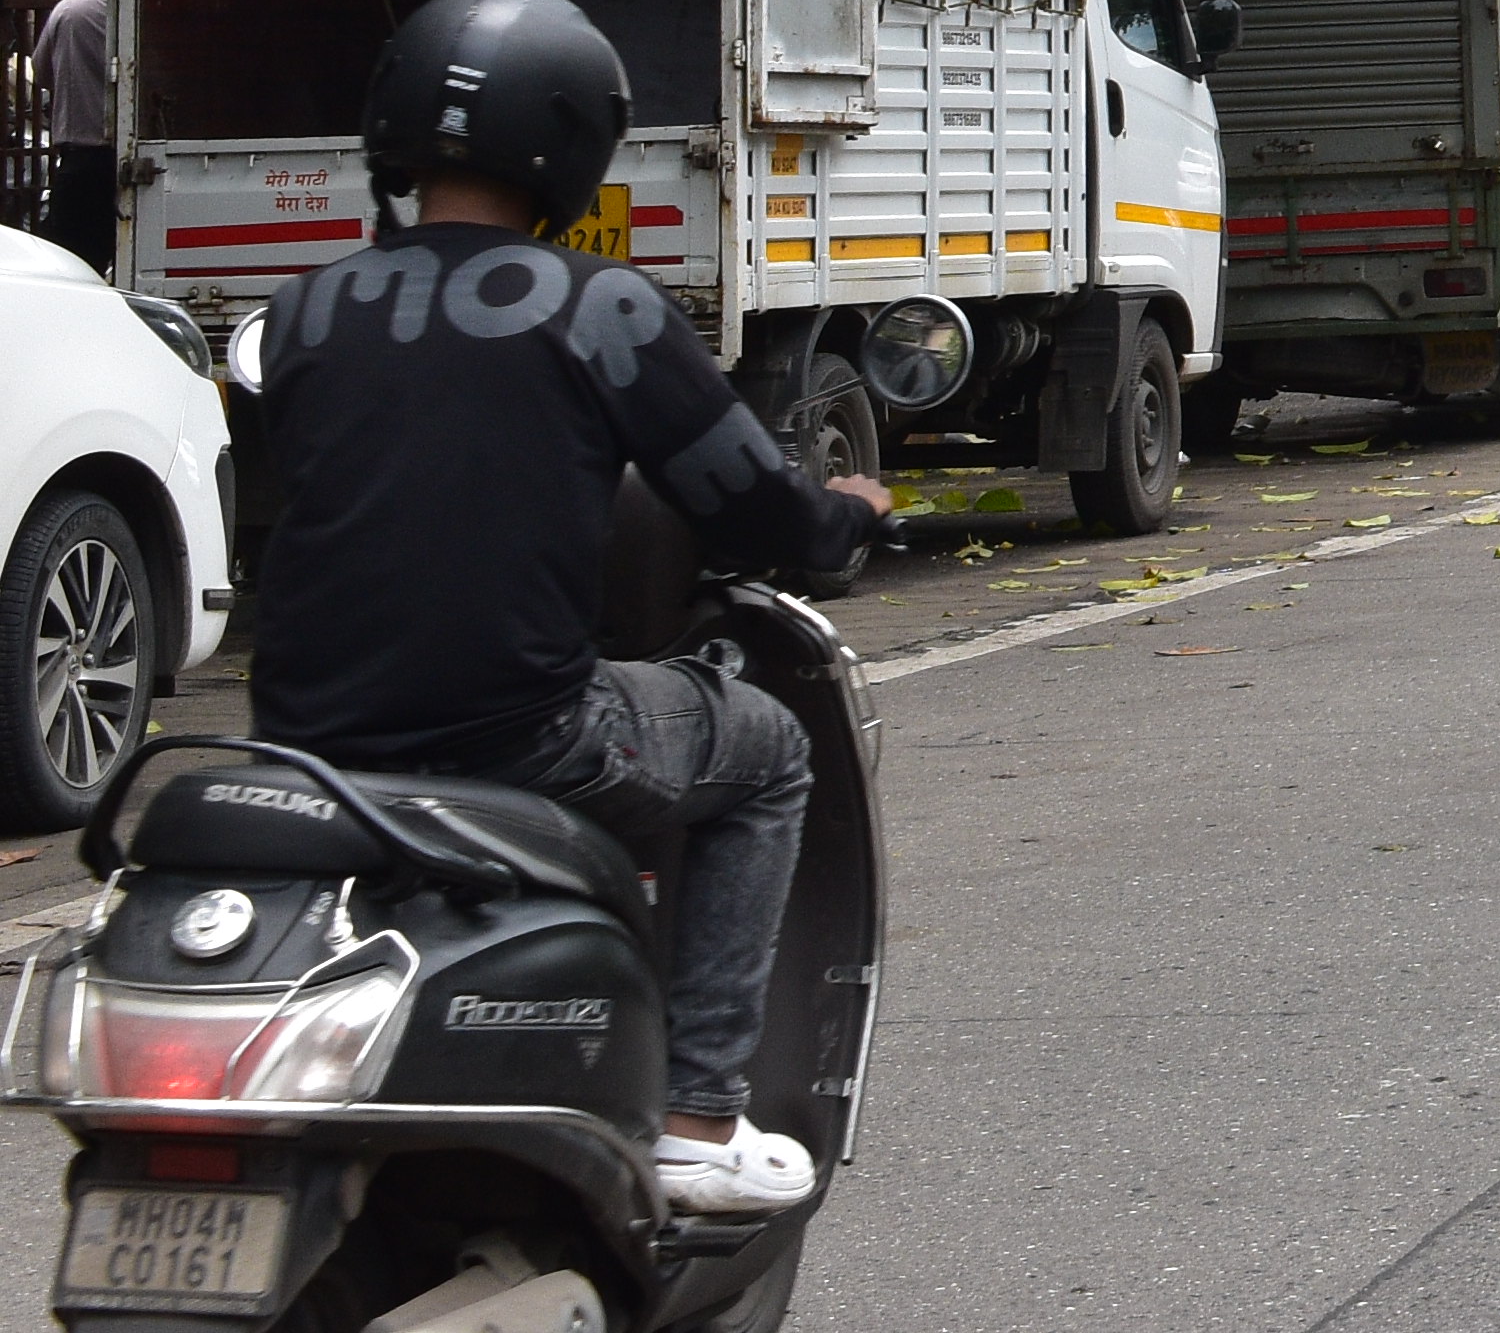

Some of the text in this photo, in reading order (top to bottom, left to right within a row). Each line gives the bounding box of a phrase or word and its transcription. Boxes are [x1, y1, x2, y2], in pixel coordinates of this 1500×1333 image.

[265, 168, 329, 187] मेरी माटी
[275, 190, 329, 212] मेरा देश
[202, 784, 339, 821] SUZUKI
[108, 1243, 234, 1288] C0161
